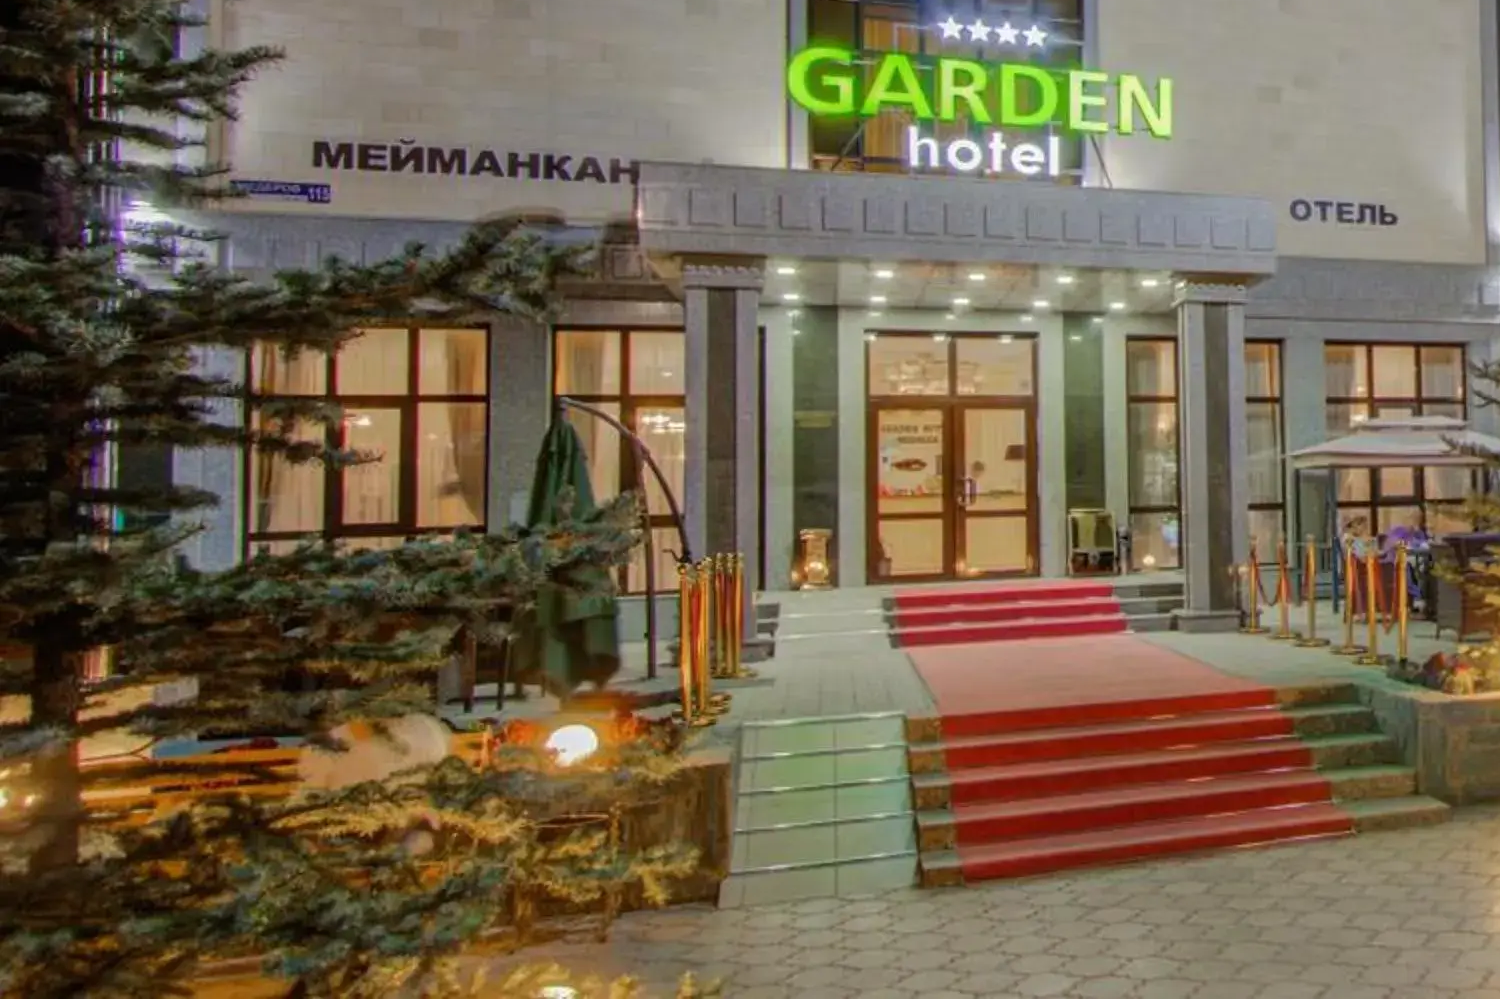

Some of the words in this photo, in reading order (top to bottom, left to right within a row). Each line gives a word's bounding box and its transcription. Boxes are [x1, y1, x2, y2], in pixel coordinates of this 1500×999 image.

[786, 46, 1173, 139] GARDEN
[907, 125, 1060, 176] hotel
[1289, 199, 1399, 226] ОТЕЛЬ
